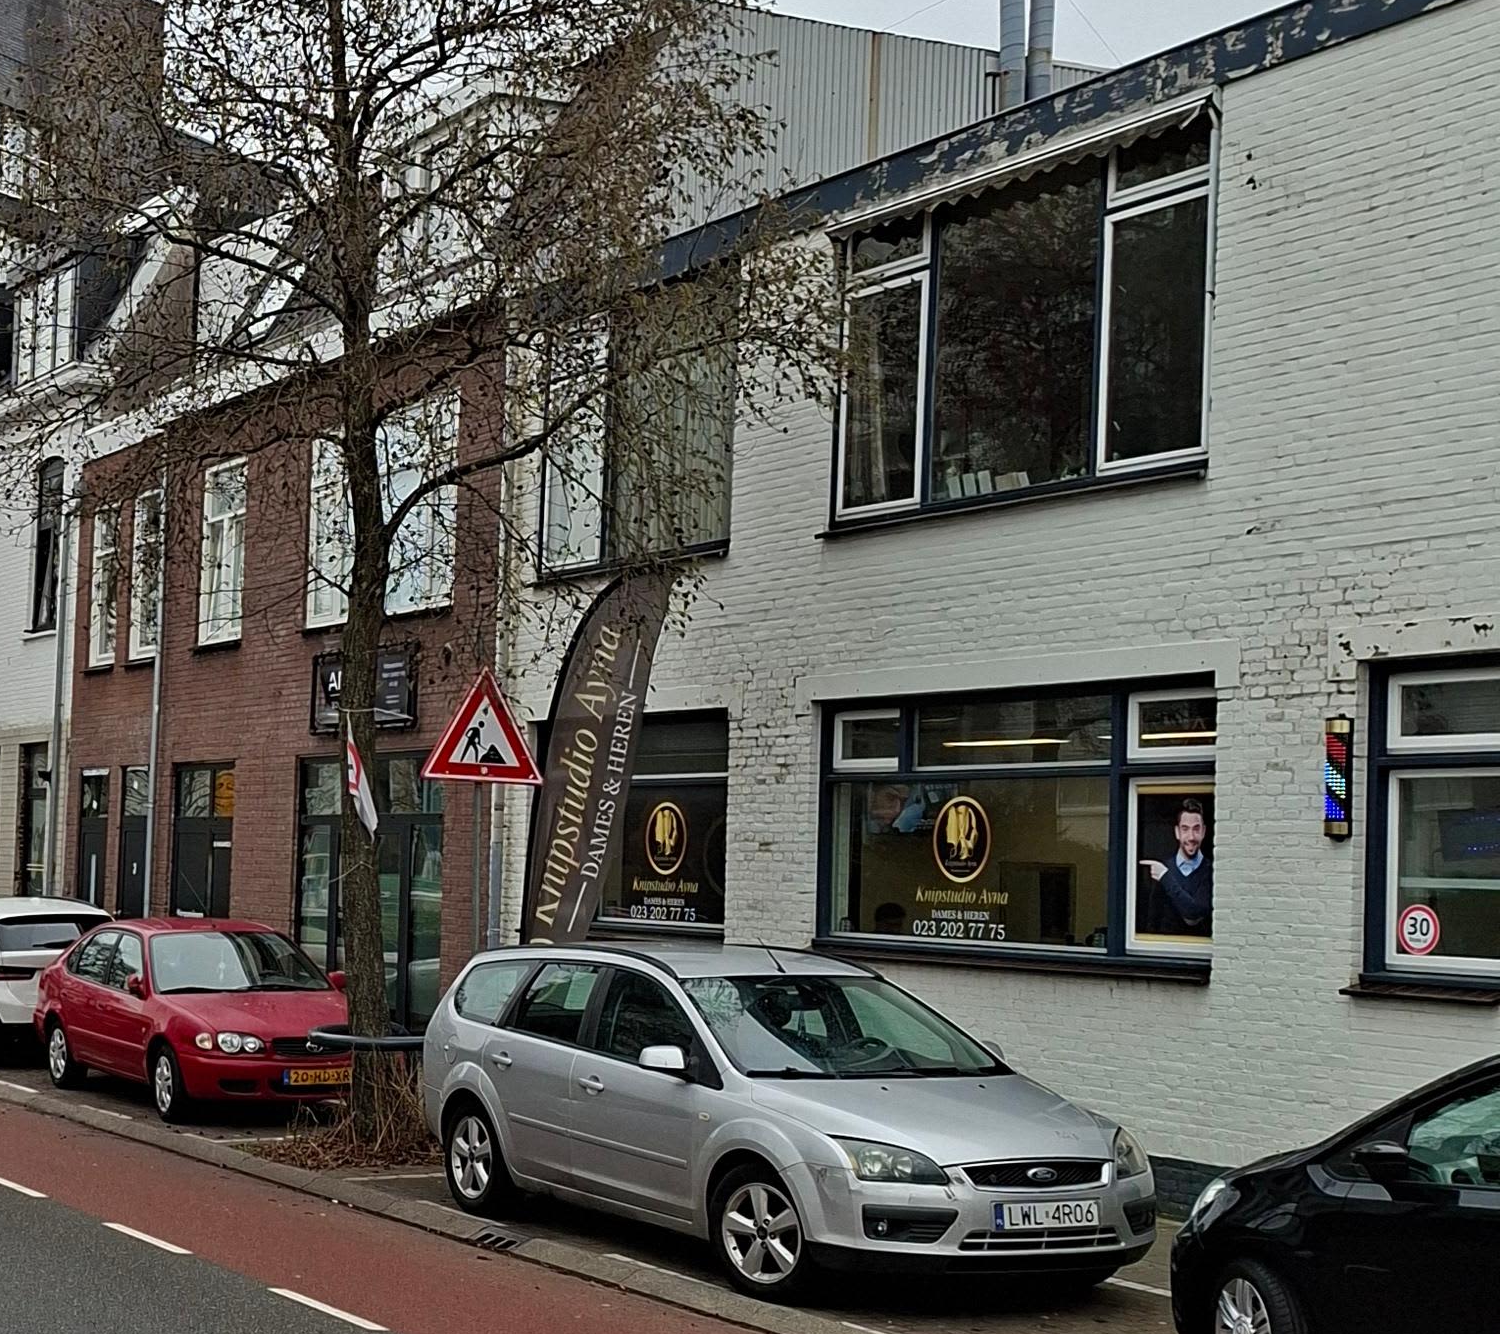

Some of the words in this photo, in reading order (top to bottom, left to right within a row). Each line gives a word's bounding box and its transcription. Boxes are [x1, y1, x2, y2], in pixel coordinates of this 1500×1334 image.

[606, 691, 638, 774] HEREN
[535, 728, 599, 927] Knipstudio
[574, 625, 621, 722] Ayna
[602, 776, 622, 796] &
[579, 799, 616, 880] DAMES
[632, 875, 676, 893] Knipstudio
[915, 885, 976, 906] Knipstudio
[630, 905, 648, 918] 023
[650, 906, 667, 919] 202
[669, 907, 682, 920] 77
[683, 908, 696, 921] 75
[931, 909, 957, 919] DAMES
[963, 910, 991, 920] HEREN
[912, 919, 937, 936] 023
[940, 920, 965, 938] 202
[968, 922, 985, 939] 77
[988, 924, 1006, 940] 75
[1407, 916, 1430, 937] 30
[1008, 1205, 1044, 1226] LWL
[1051, 1202, 1095, 1224] 4R06
